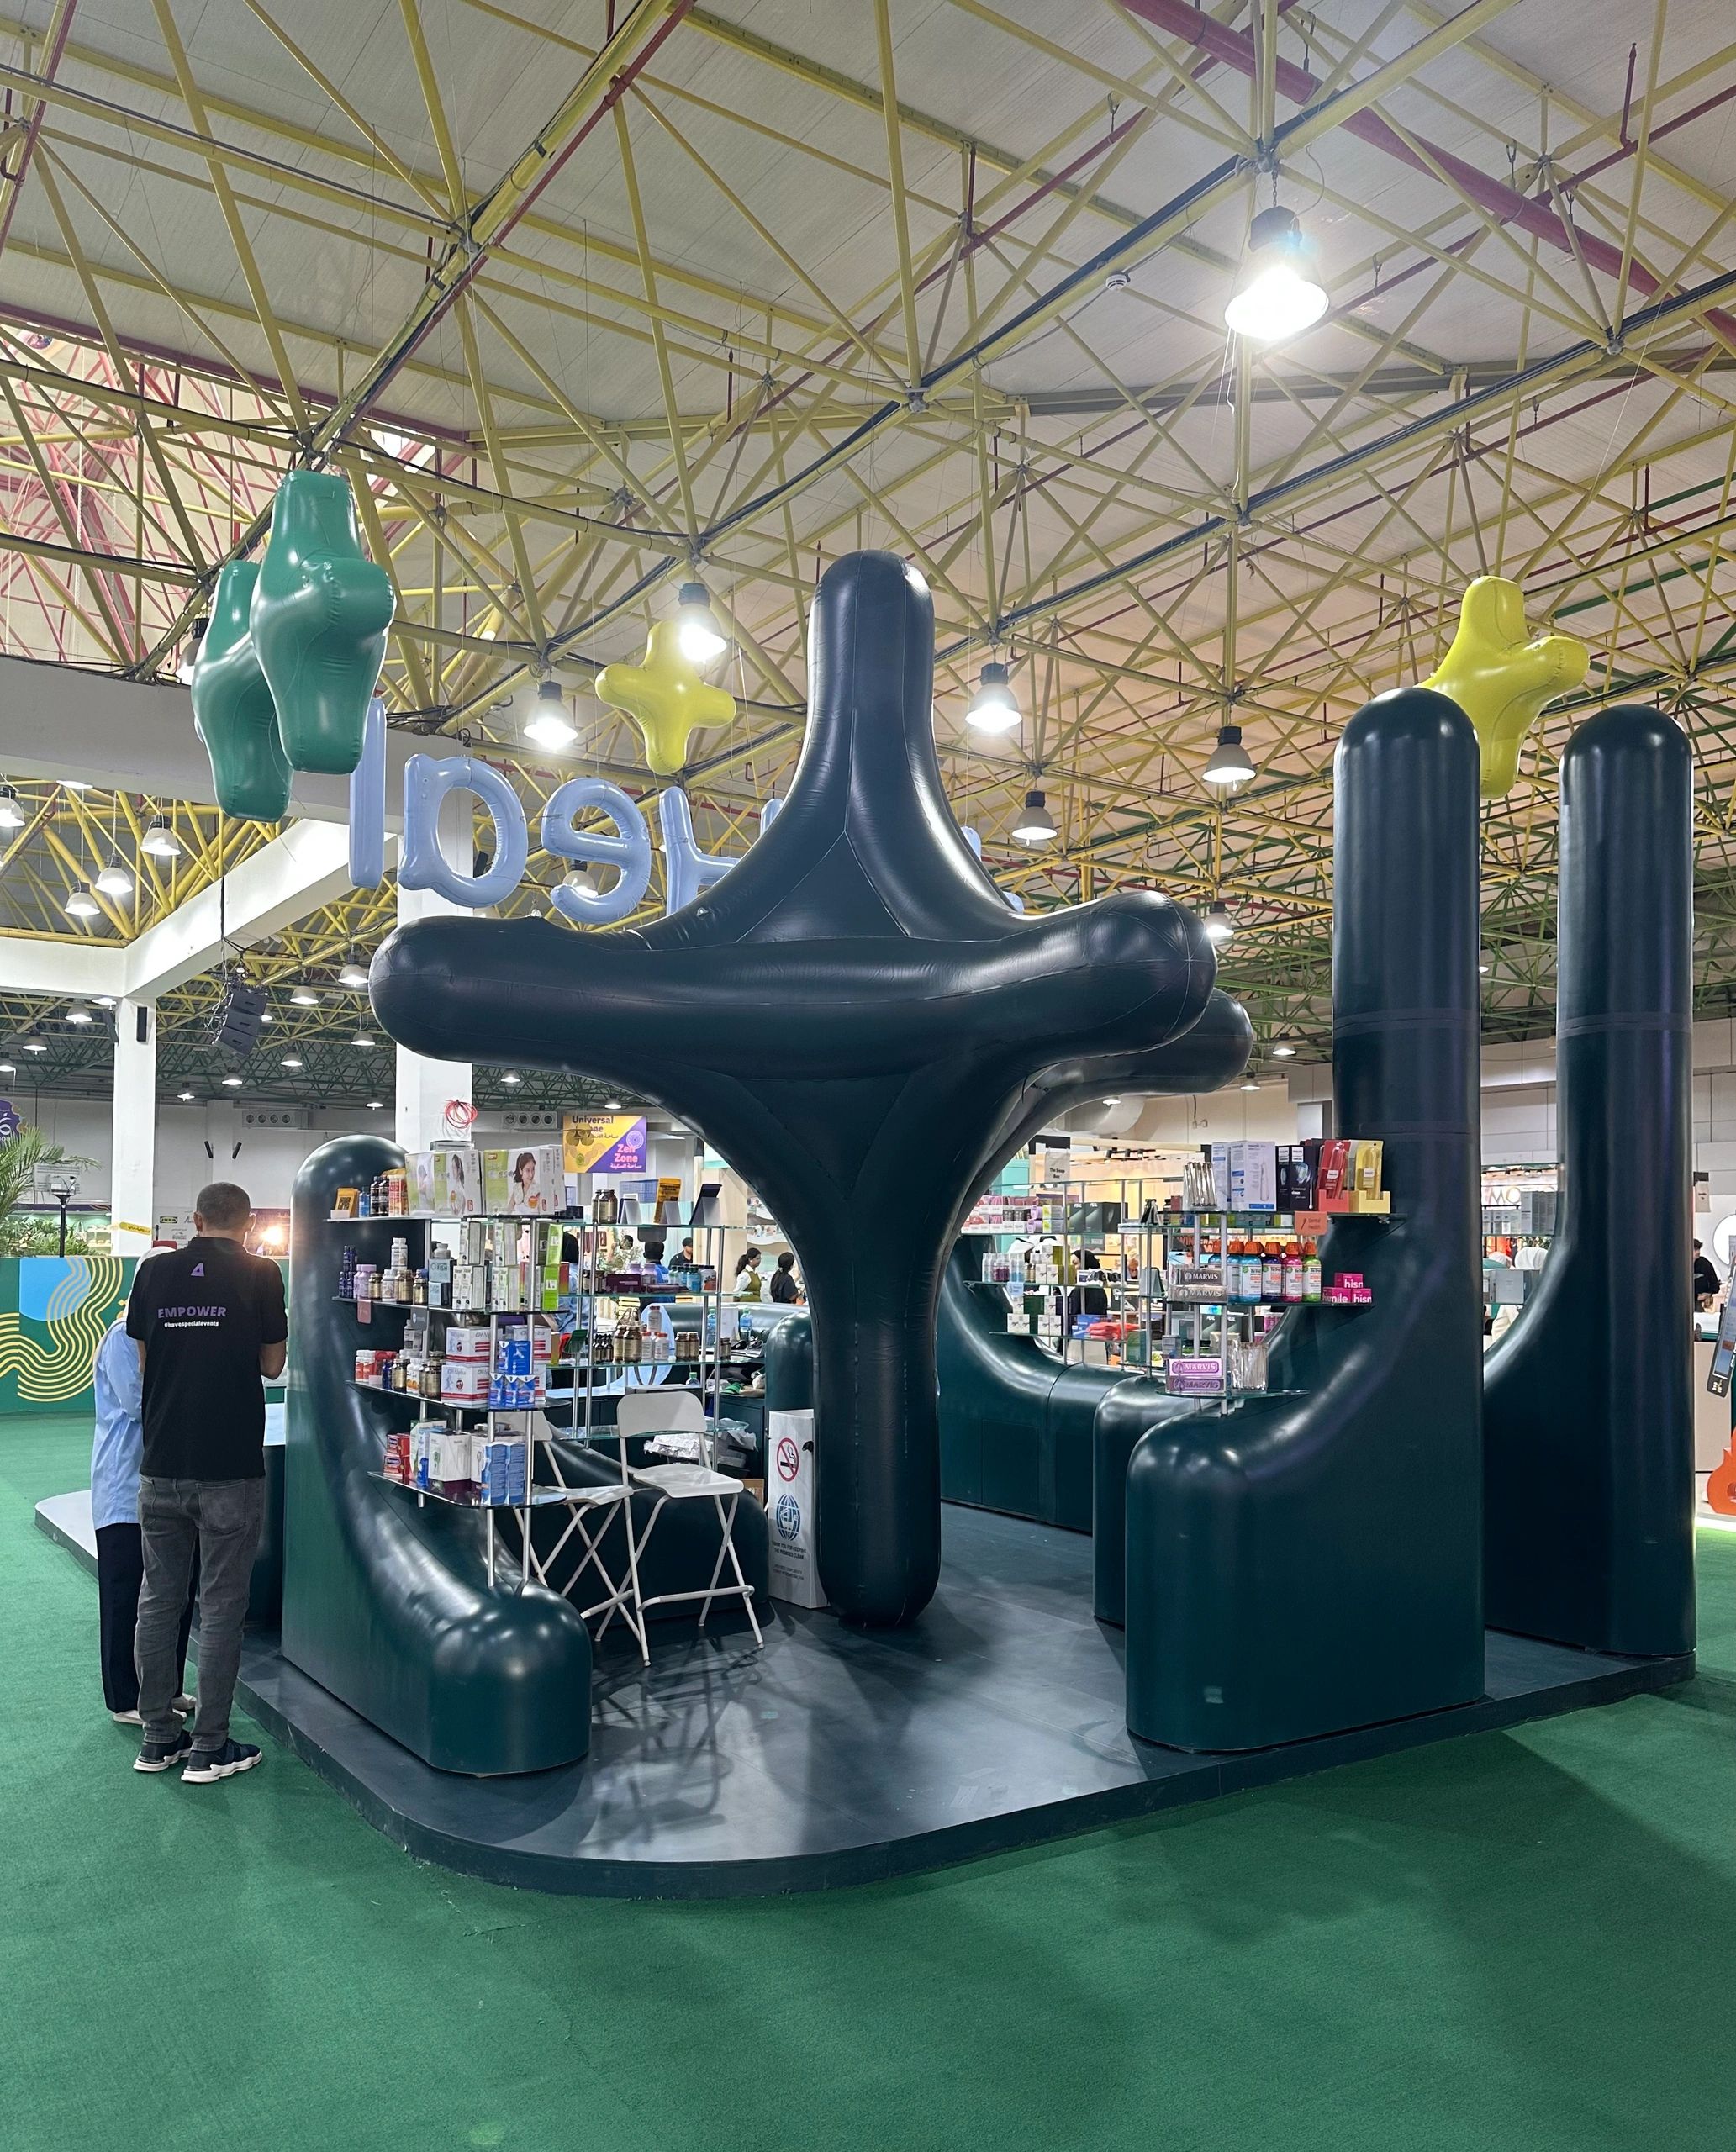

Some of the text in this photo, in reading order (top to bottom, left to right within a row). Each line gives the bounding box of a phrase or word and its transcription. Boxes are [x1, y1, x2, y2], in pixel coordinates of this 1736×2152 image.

[572, 1116, 614, 1124] Universal
[617, 1144, 636, 1153] Zen
[614, 1153, 638, 1163] Zone
[157, 1306, 227, 1319] EMPOWER
